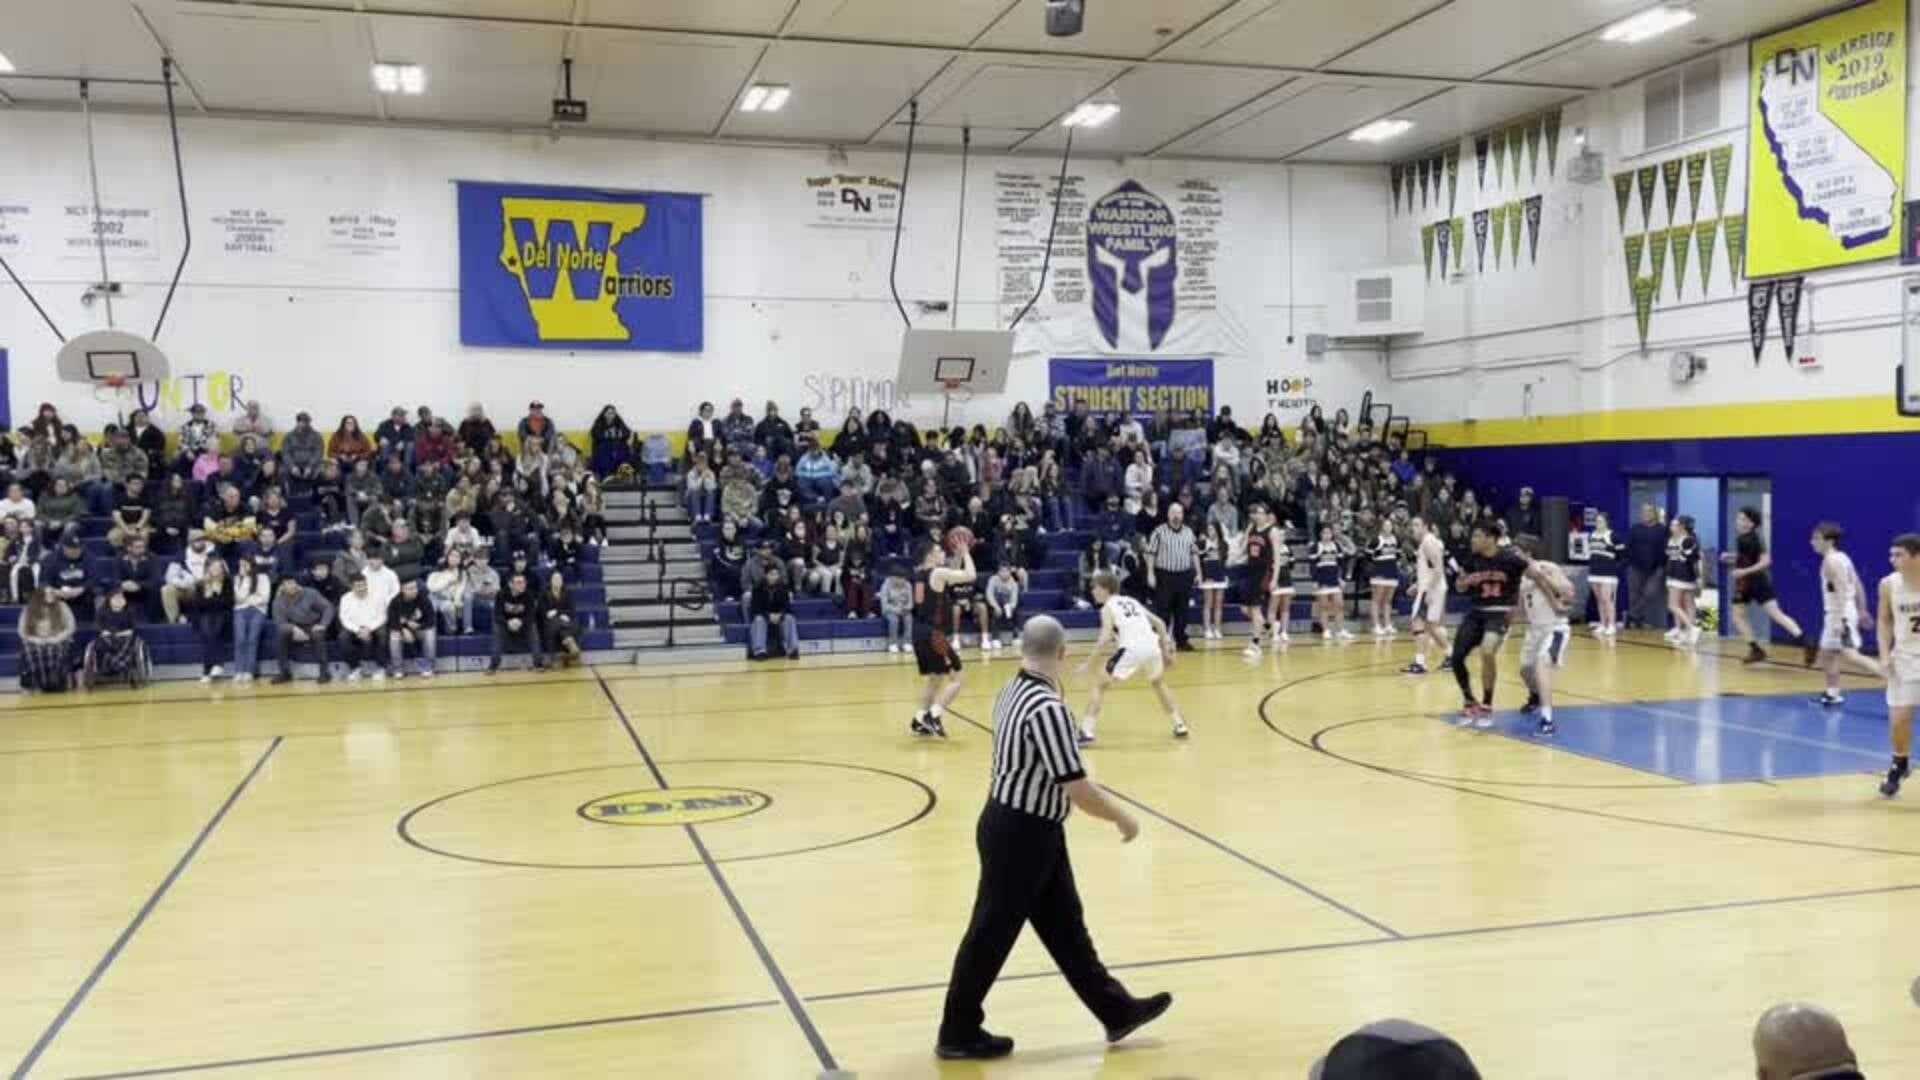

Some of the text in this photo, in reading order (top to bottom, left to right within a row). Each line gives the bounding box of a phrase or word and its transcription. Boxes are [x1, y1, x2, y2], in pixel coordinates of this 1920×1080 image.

[1824, 31, 1896, 65] WARRIOR
[1839, 52, 1885, 81] 2019
[1827, 71, 1894, 100] FOOTBALL
[841, 187, 872, 212] DN
[1096, 208, 1168, 221] WARRIOR
[1087, 222, 1177, 237] WRESTLING
[523, 240, 605, 270] Del Norte
[1105, 237, 1160, 252] FAMILY
[1106, 363, 1126, 378] Del
[1055, 385, 1209, 412] STUDENT SECTION
